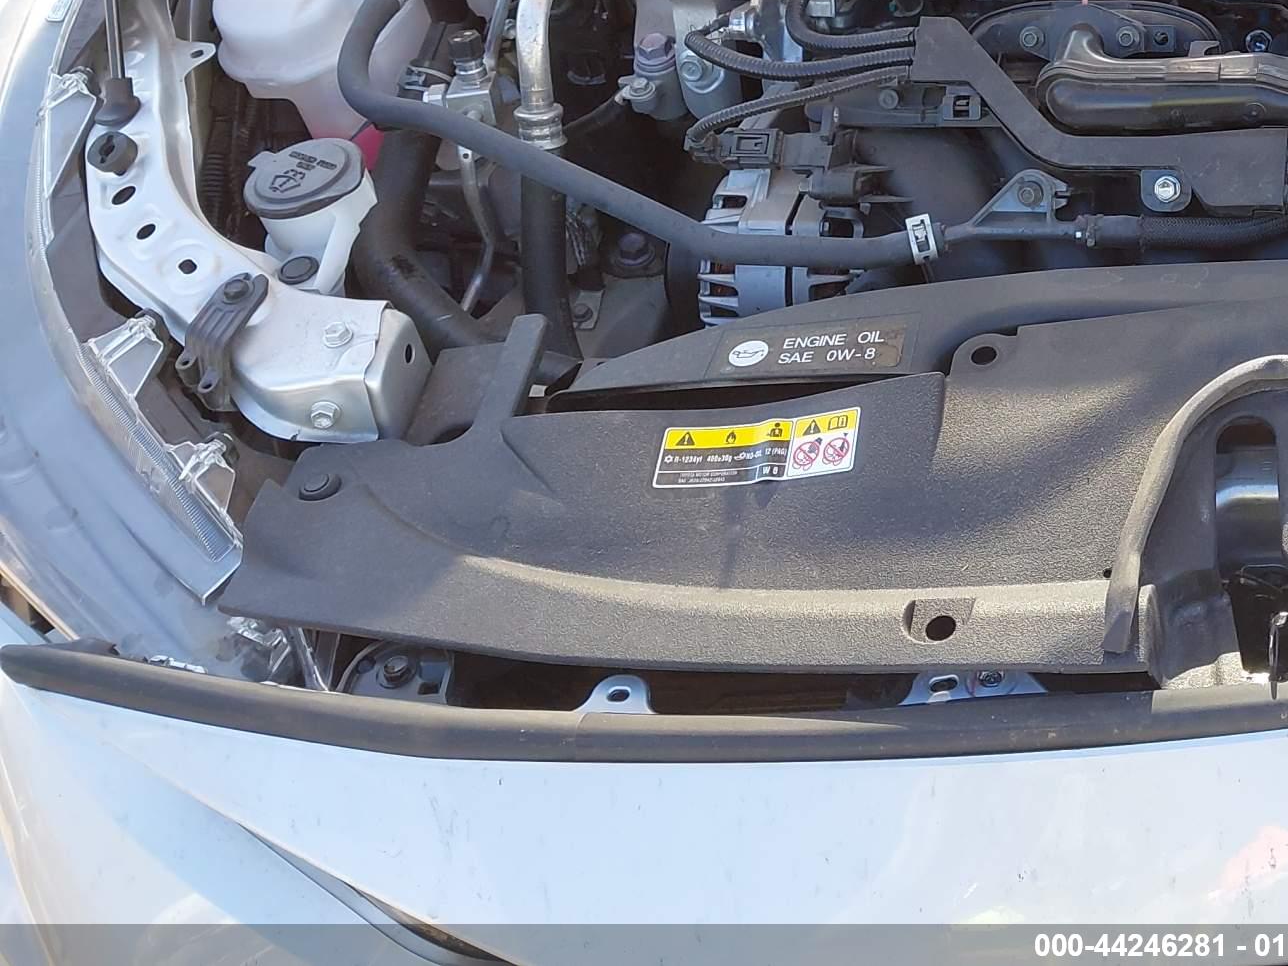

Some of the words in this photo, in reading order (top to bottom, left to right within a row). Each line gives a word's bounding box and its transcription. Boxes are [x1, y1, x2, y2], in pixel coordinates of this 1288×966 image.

[782, 333, 847, 350] ENGINE
[857, 330, 885, 344] OIL
[778, 351, 815, 364] SAE
[826, 347, 876, 362] 0W-8
